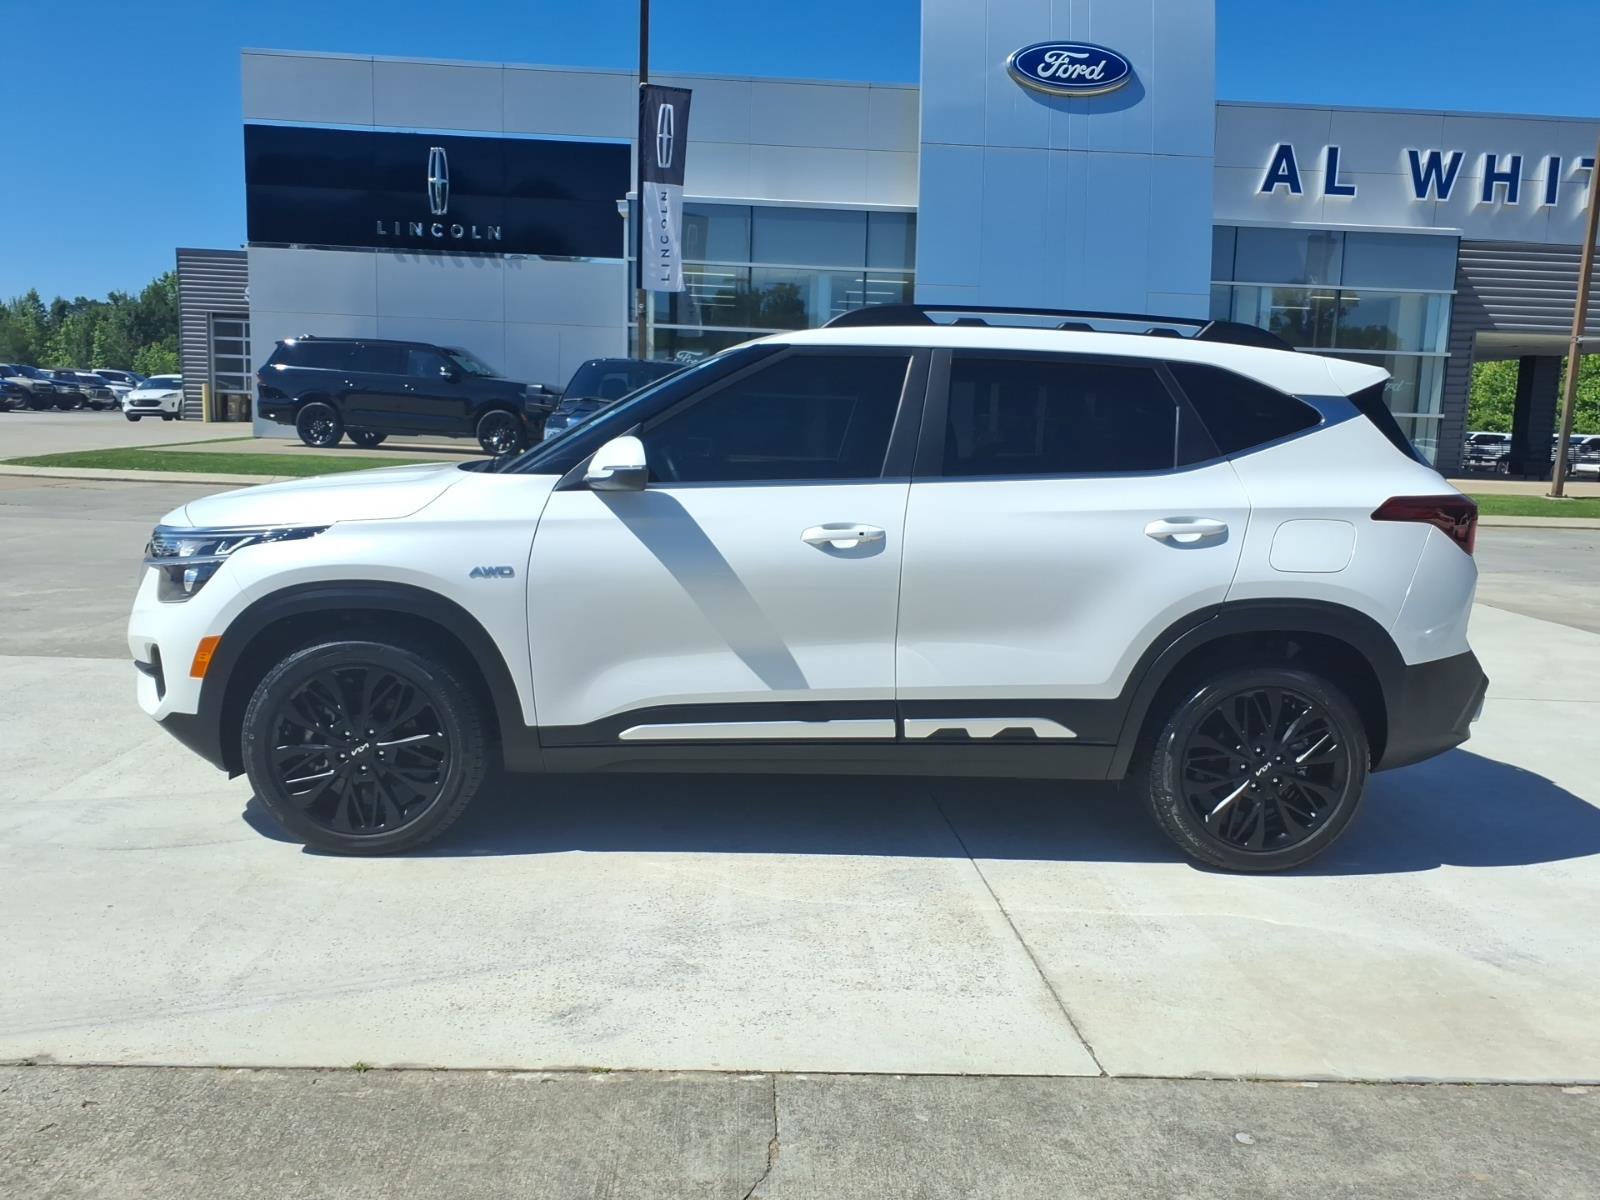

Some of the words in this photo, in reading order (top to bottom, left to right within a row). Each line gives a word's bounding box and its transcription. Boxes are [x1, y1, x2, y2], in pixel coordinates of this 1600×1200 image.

[1037, 50, 1107, 80] Ford
[1258, 143, 1357, 198] AL
[376, 220, 501, 240] LINCOLN
[660, 191, 671, 282] LINCOLN
[468, 566, 516, 578] AWD
